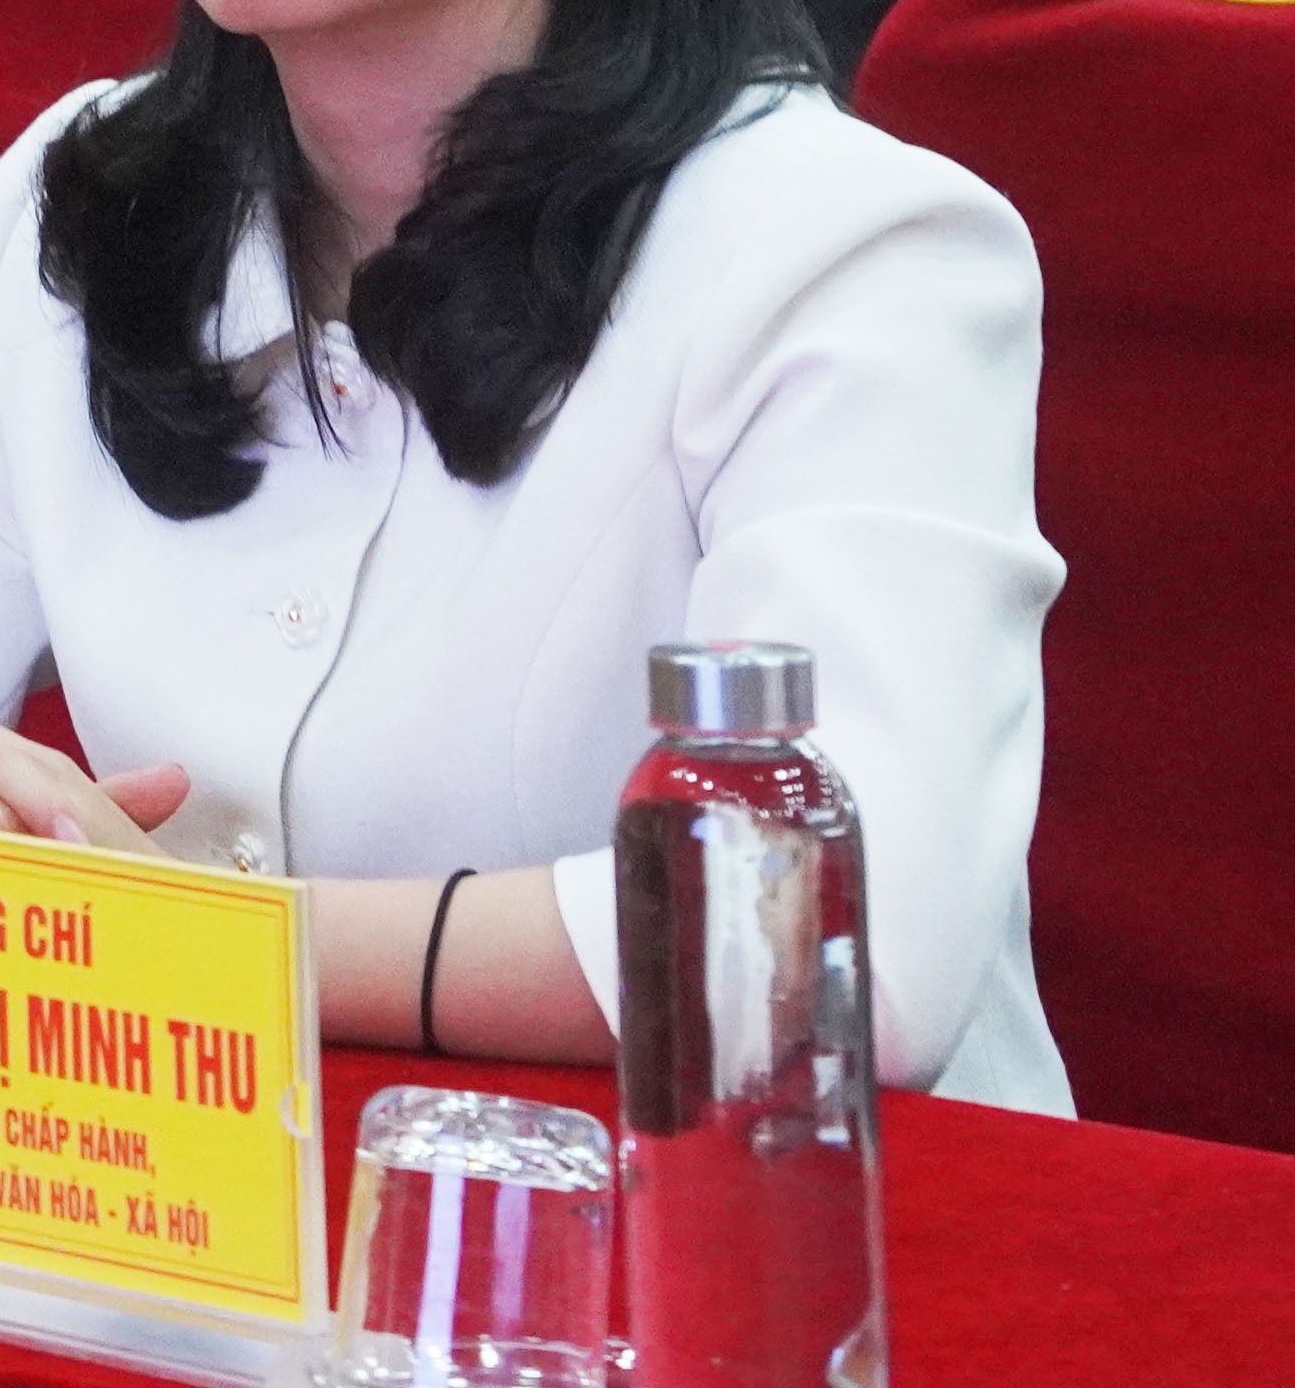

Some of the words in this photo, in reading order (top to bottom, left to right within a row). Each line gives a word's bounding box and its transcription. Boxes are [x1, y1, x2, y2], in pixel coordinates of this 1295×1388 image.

[23, 901, 94, 969] CHÍ
[26, 993, 153, 1097] MINH
[166, 1018, 259, 1116] THU
[4, 1100, 71, 1156] CHẤP
[78, 1115, 157, 1179] HÀNH,
[49, 1174, 101, 1228] HÓA
[107, 1208, 118, 1219] -
[125, 1189, 159, 1239] XÃ
[166, 1197, 211, 1257] HỘI
